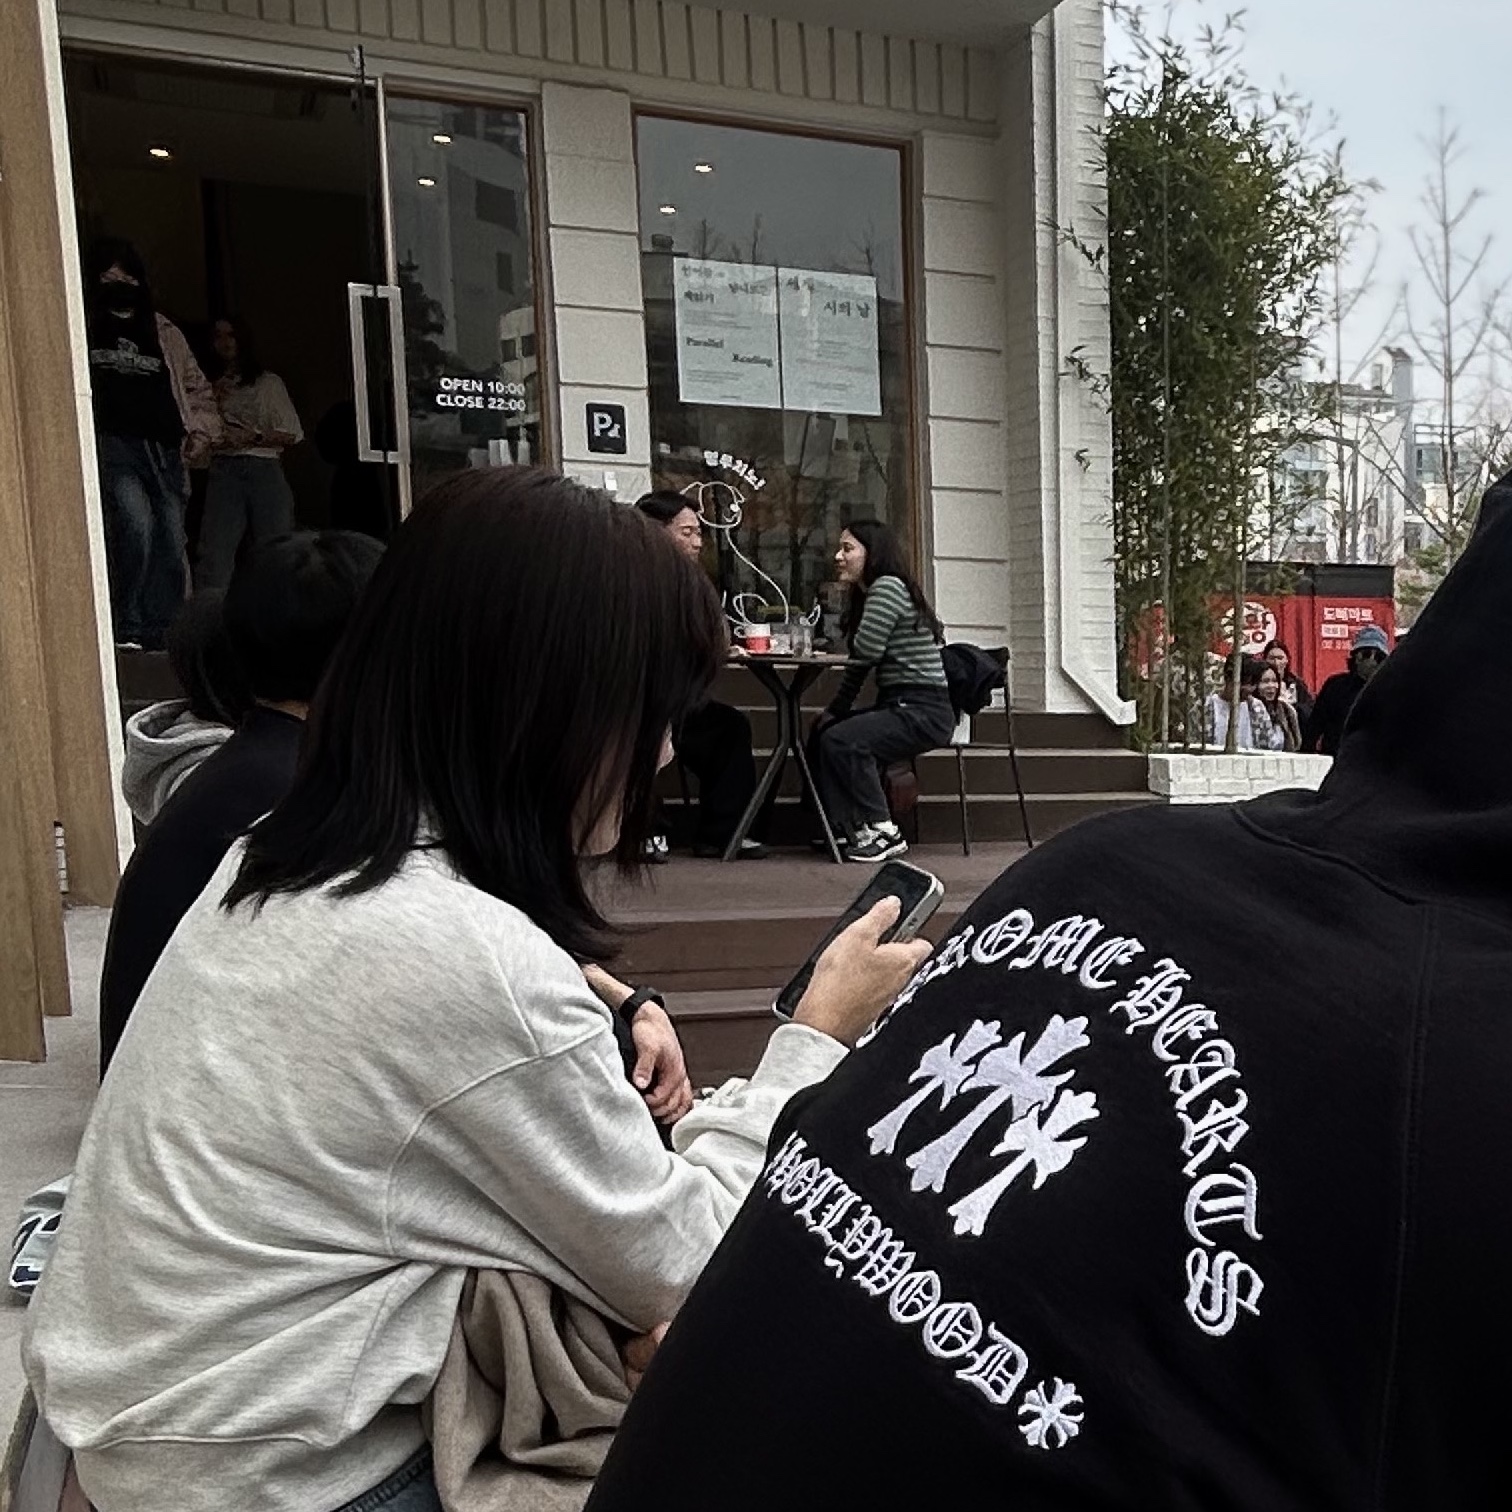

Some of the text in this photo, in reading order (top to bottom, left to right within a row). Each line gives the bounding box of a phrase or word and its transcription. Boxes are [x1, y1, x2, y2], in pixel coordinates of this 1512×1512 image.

[732, 352, 773, 368] Reading
[439, 377, 526, 396] OPEN 10:00
[435, 393, 527, 411] CLOSE 22:00
[1109, 958, 1265, 1337] HEARTS
[764, 1132, 1029, 1405] HOLLYWOOD
